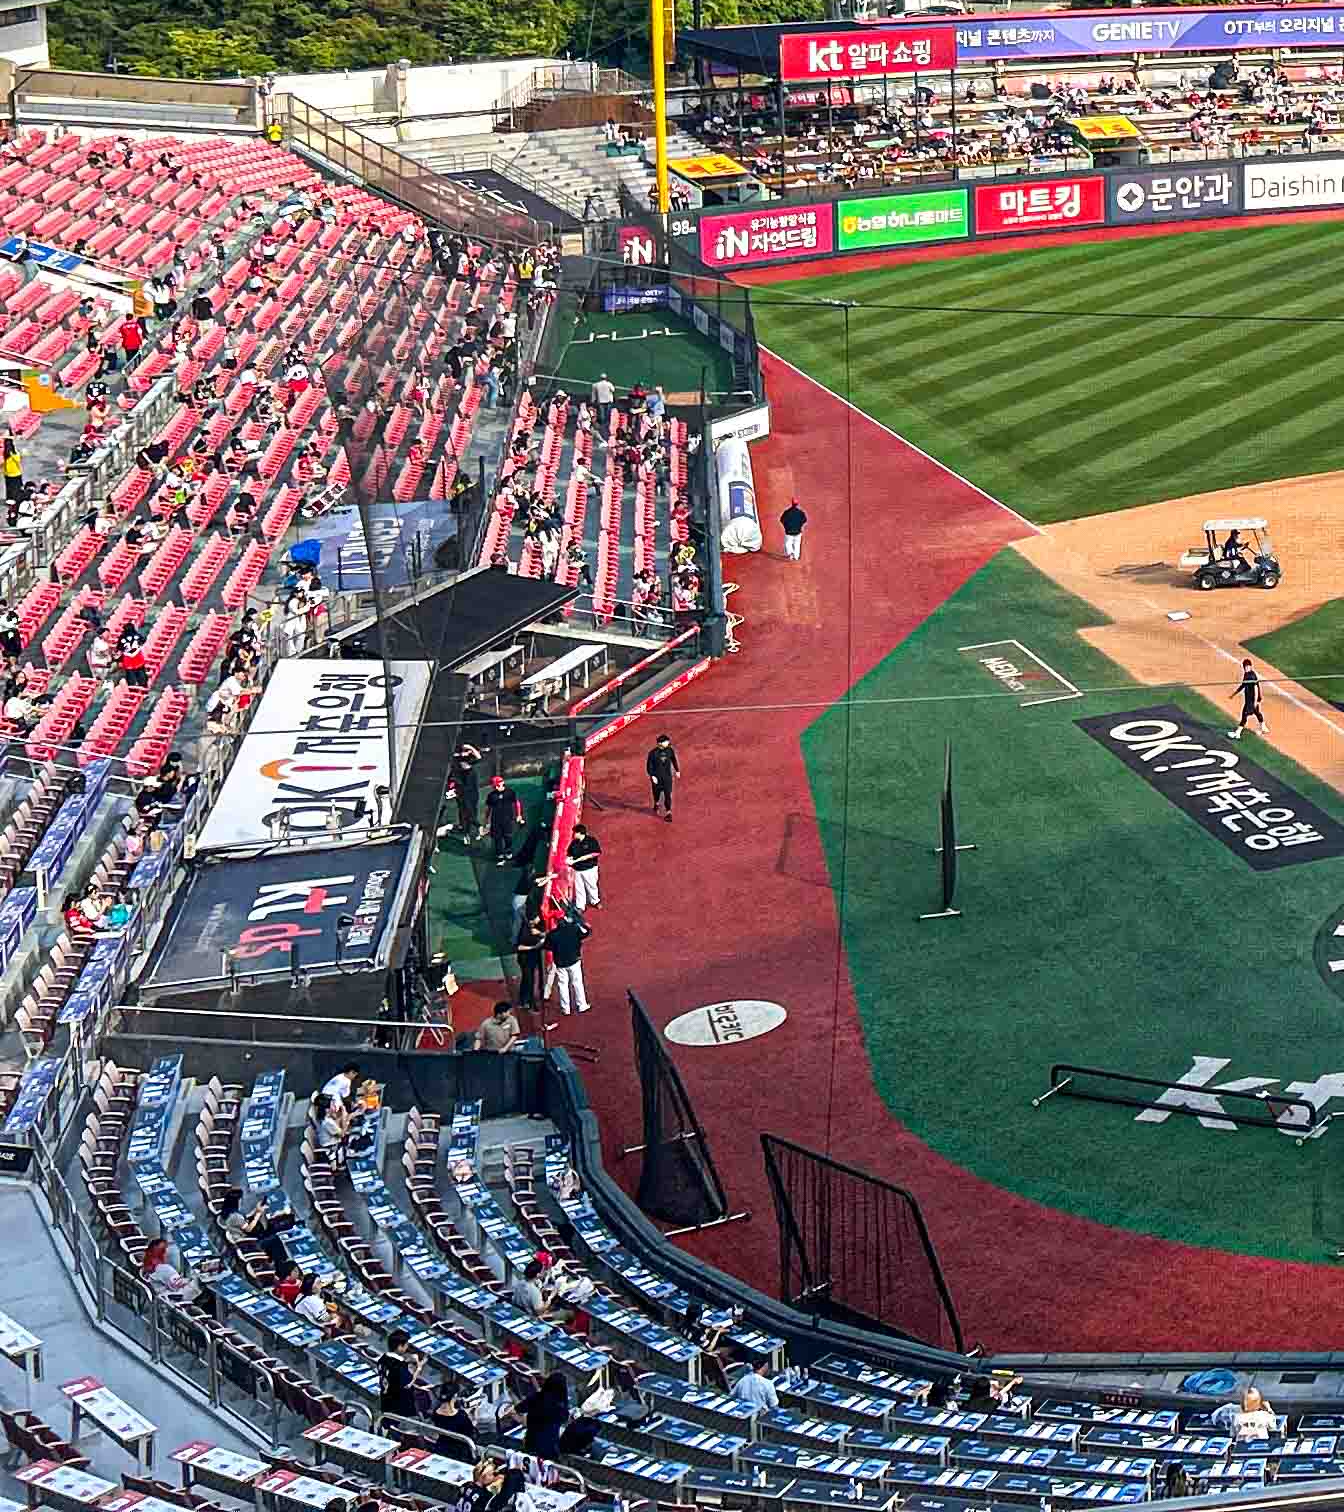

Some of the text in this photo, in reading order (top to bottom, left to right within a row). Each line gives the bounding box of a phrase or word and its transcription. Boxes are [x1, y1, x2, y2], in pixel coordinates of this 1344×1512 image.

[1092, 22, 1152, 42] GENIE
[1153, 21, 1180, 40] TV
[1223, 18, 1277, 36] OTT부터
[1279, 16, 1335, 34] 오리지널
[809, 39, 932, 72] kt 알파 쇼핑
[999, 185, 1081, 217] 마트킹
[1146, 174, 1233, 212] 문안과
[1249, 175, 1337, 200] Daishin
[751, 225, 817, 253] 자연드림
[247, 875, 355, 921] kt
